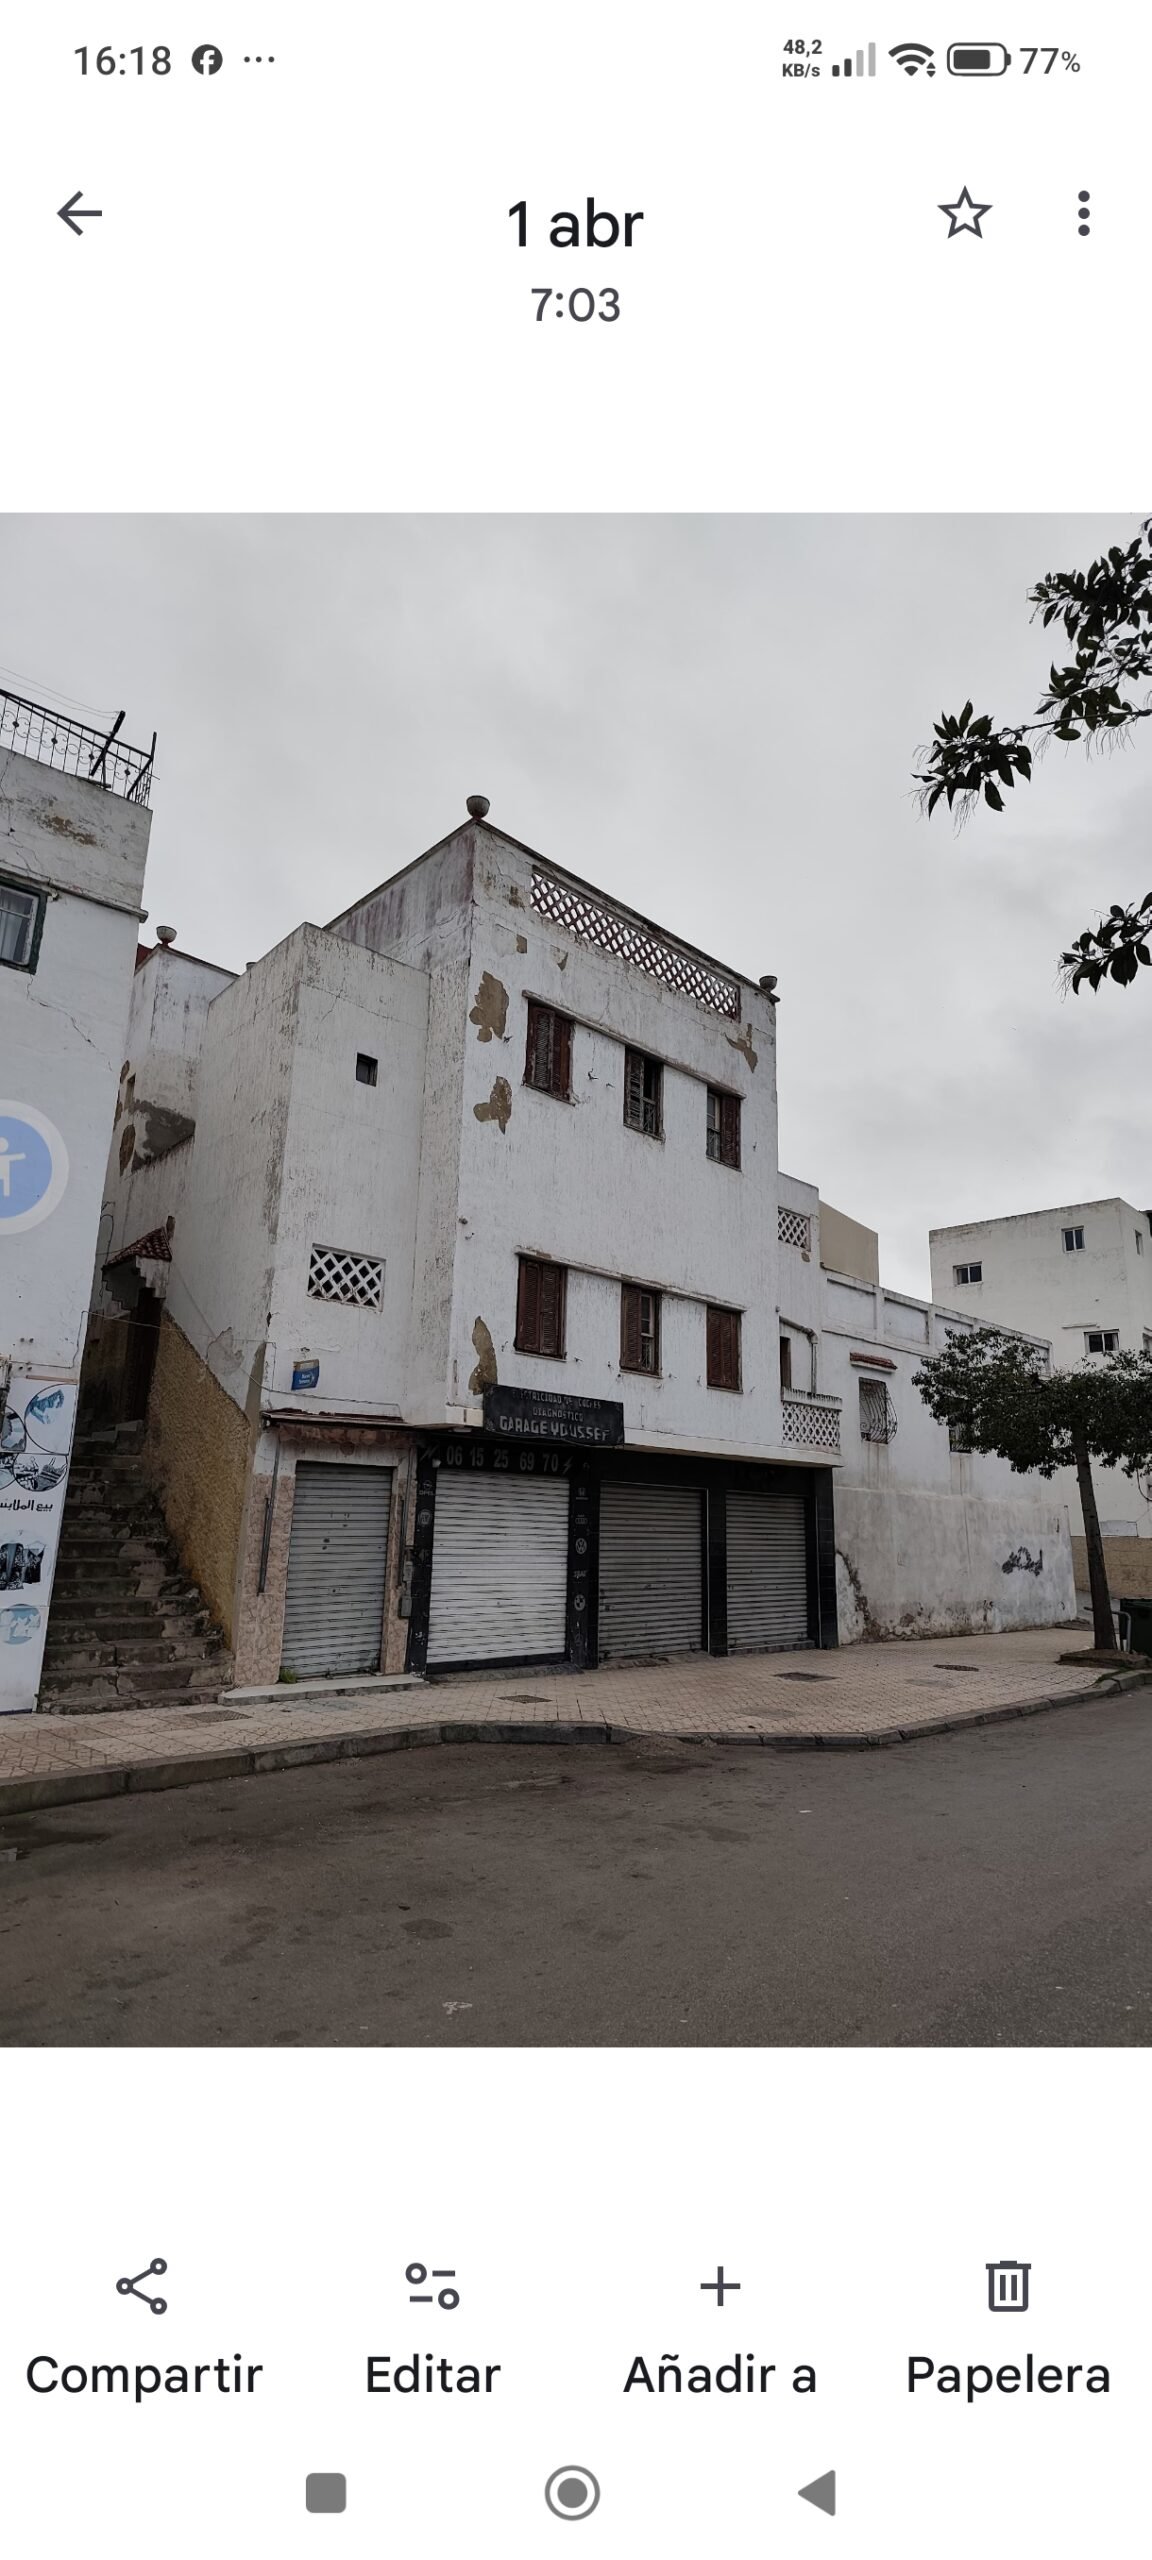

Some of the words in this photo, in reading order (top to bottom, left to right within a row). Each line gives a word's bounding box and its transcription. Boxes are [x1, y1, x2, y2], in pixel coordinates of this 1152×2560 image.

[499, 1415, 548, 1434] GARAGE
[550, 1421, 611, 1441] YOUSSEF
[446, 1444, 463, 1466] 06
[469, 1446, 484, 1467] 15
[492, 1448, 509, 1469] 25
[519, 1451, 535, 1472] 69
[541, 1453, 559, 1473] 70
[36, 1503, 54, 1512] بيع
